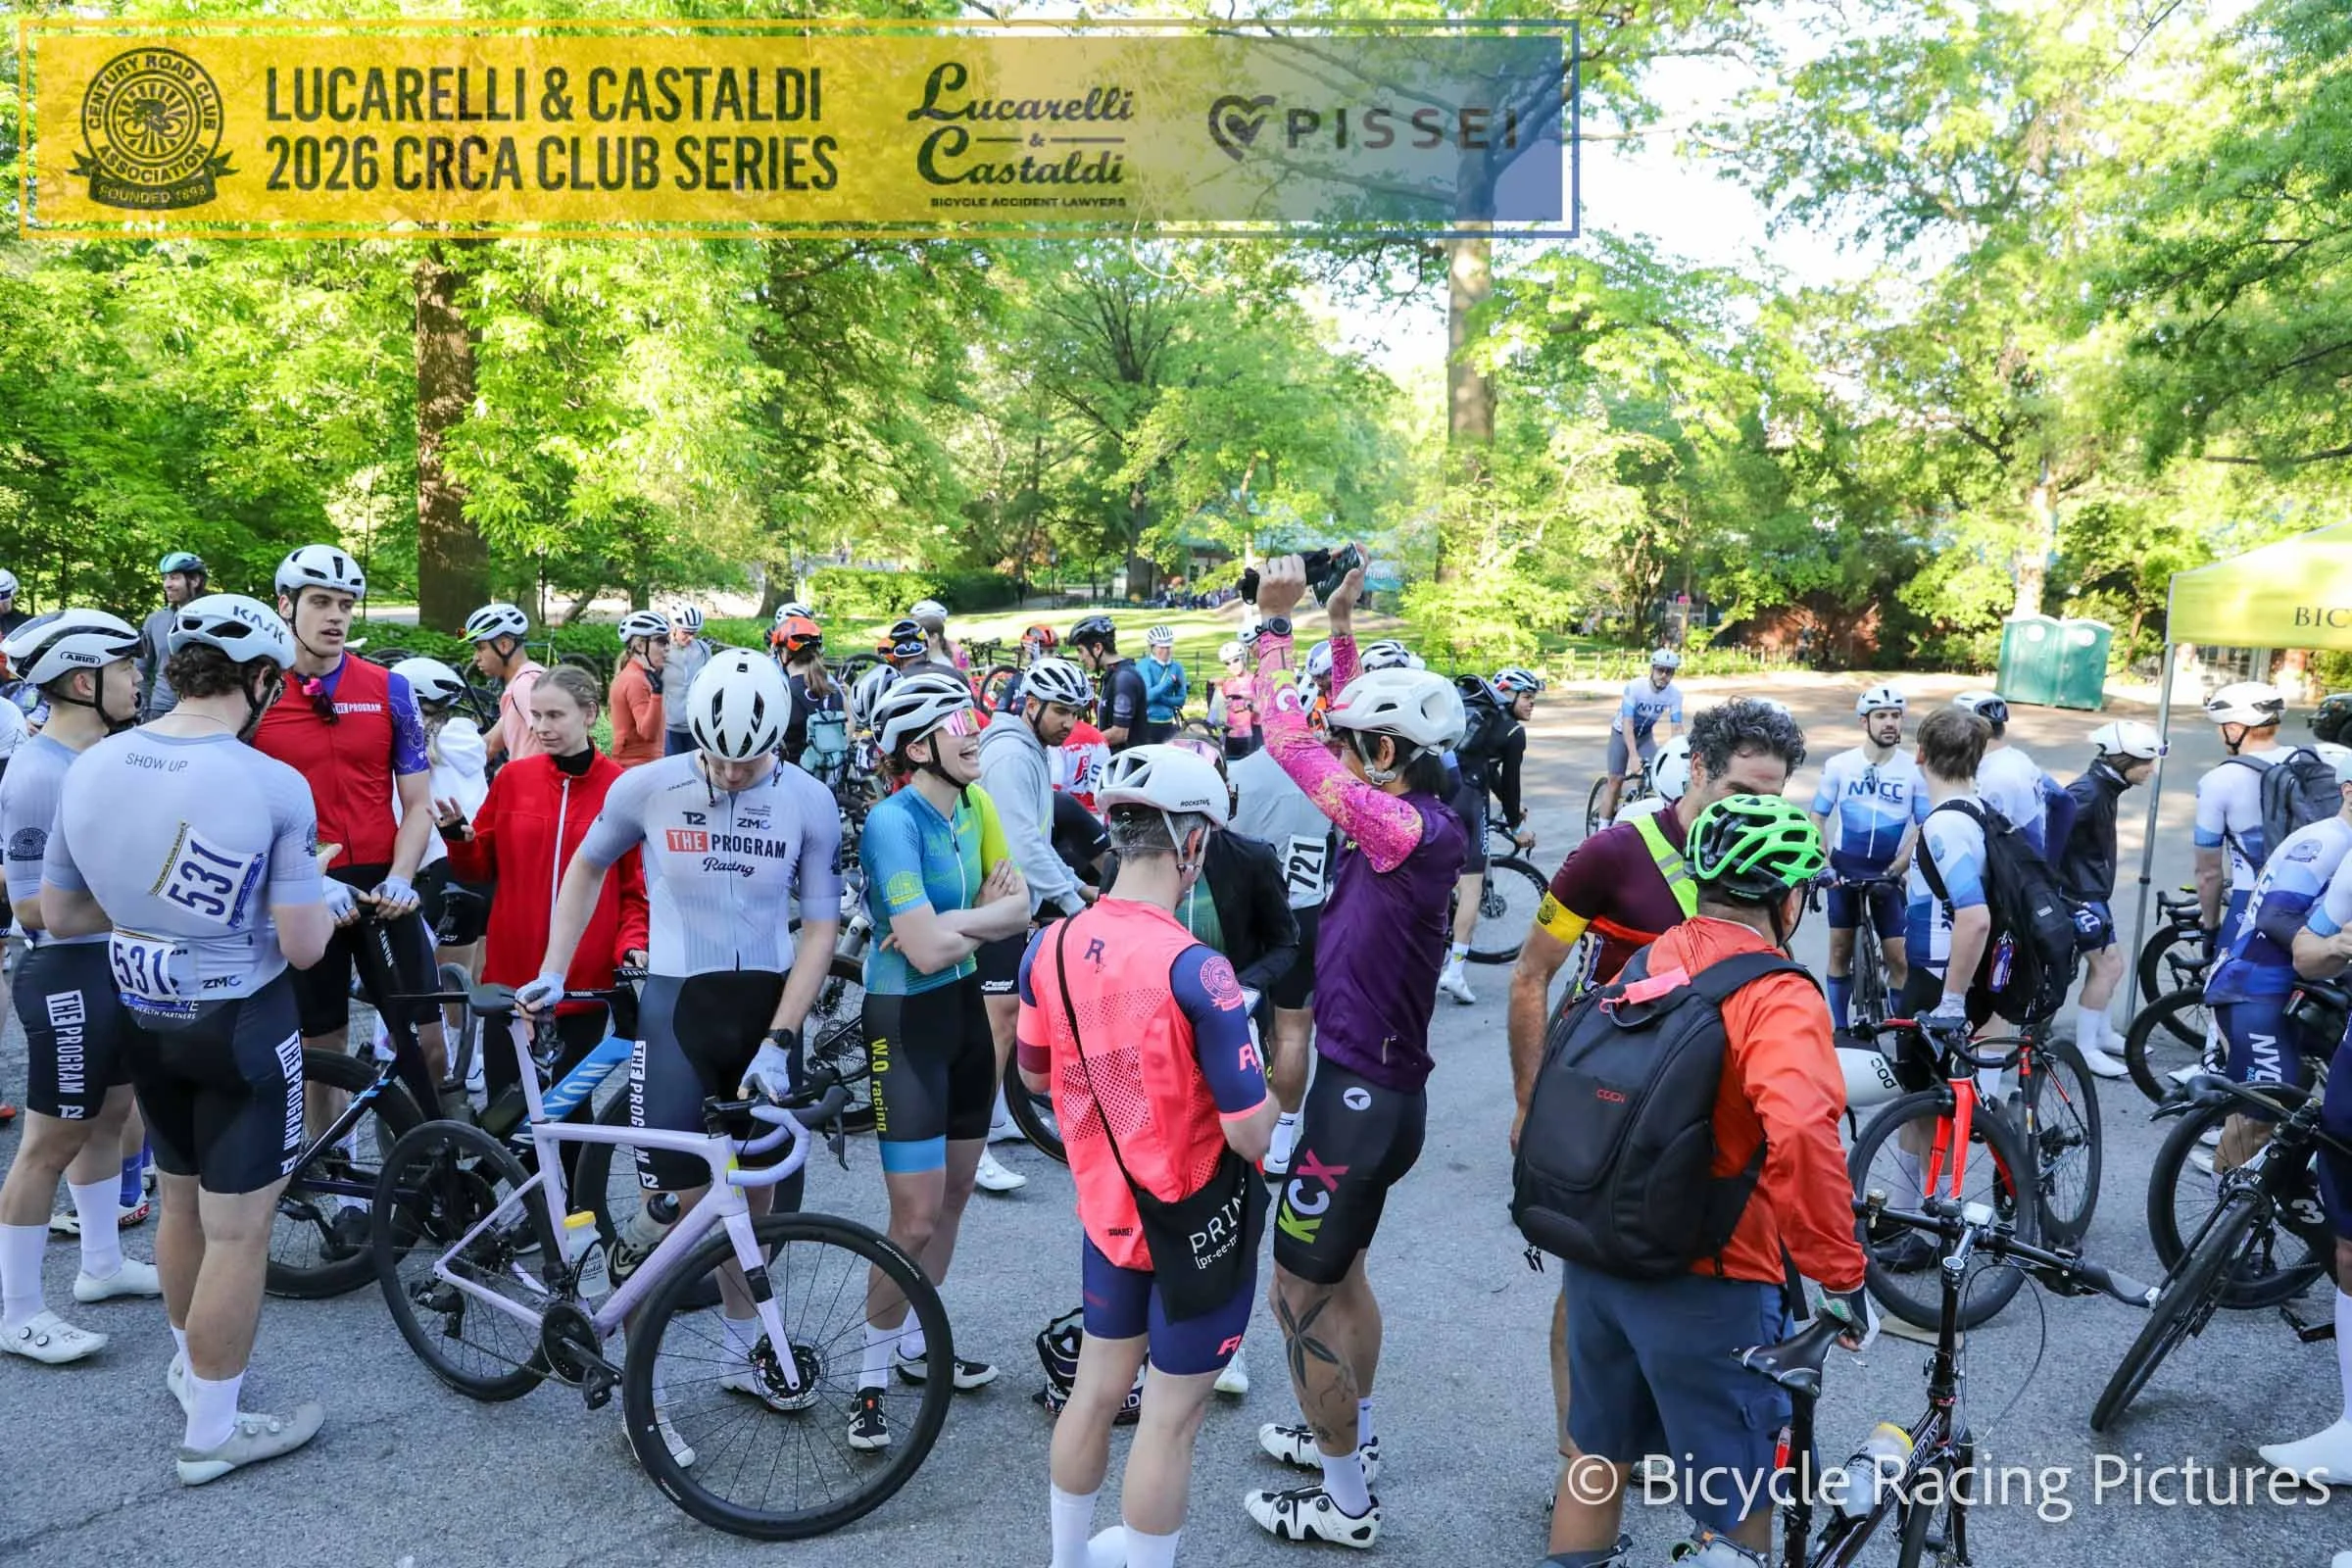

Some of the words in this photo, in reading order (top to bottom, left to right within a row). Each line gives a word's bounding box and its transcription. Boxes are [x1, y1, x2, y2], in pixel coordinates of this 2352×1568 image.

[232, 605, 286, 645] KASK
[65, 653, 96, 664] ABUS
[125, 753, 167, 769] SHOW
[168, 760, 189, 773] UP
[682, 810, 707, 826] T2
[736, 817, 771, 830] ZMC
[670, 831, 704, 851] THE
[711, 833, 787, 859] PROGRAM
[167, 839, 244, 917] 531
[702, 857, 756, 878] Racing
[1286, 842, 1325, 890] 721
[113, 940, 172, 996] 531
[203, 974, 242, 990] ZMC
[50, 993, 83, 1023] THE
[162, 1010, 196, 1020] PARTNERS
[55, 1025, 85, 1094] PROGRAM
[280, 1036, 302, 1075] THE
[630, 1041, 646, 1080] THE
[283, 1068, 304, 1152] PROGRAM
[629, 1081, 652, 1164] PROGM
[1277, 1148, 1350, 1246] KCX
